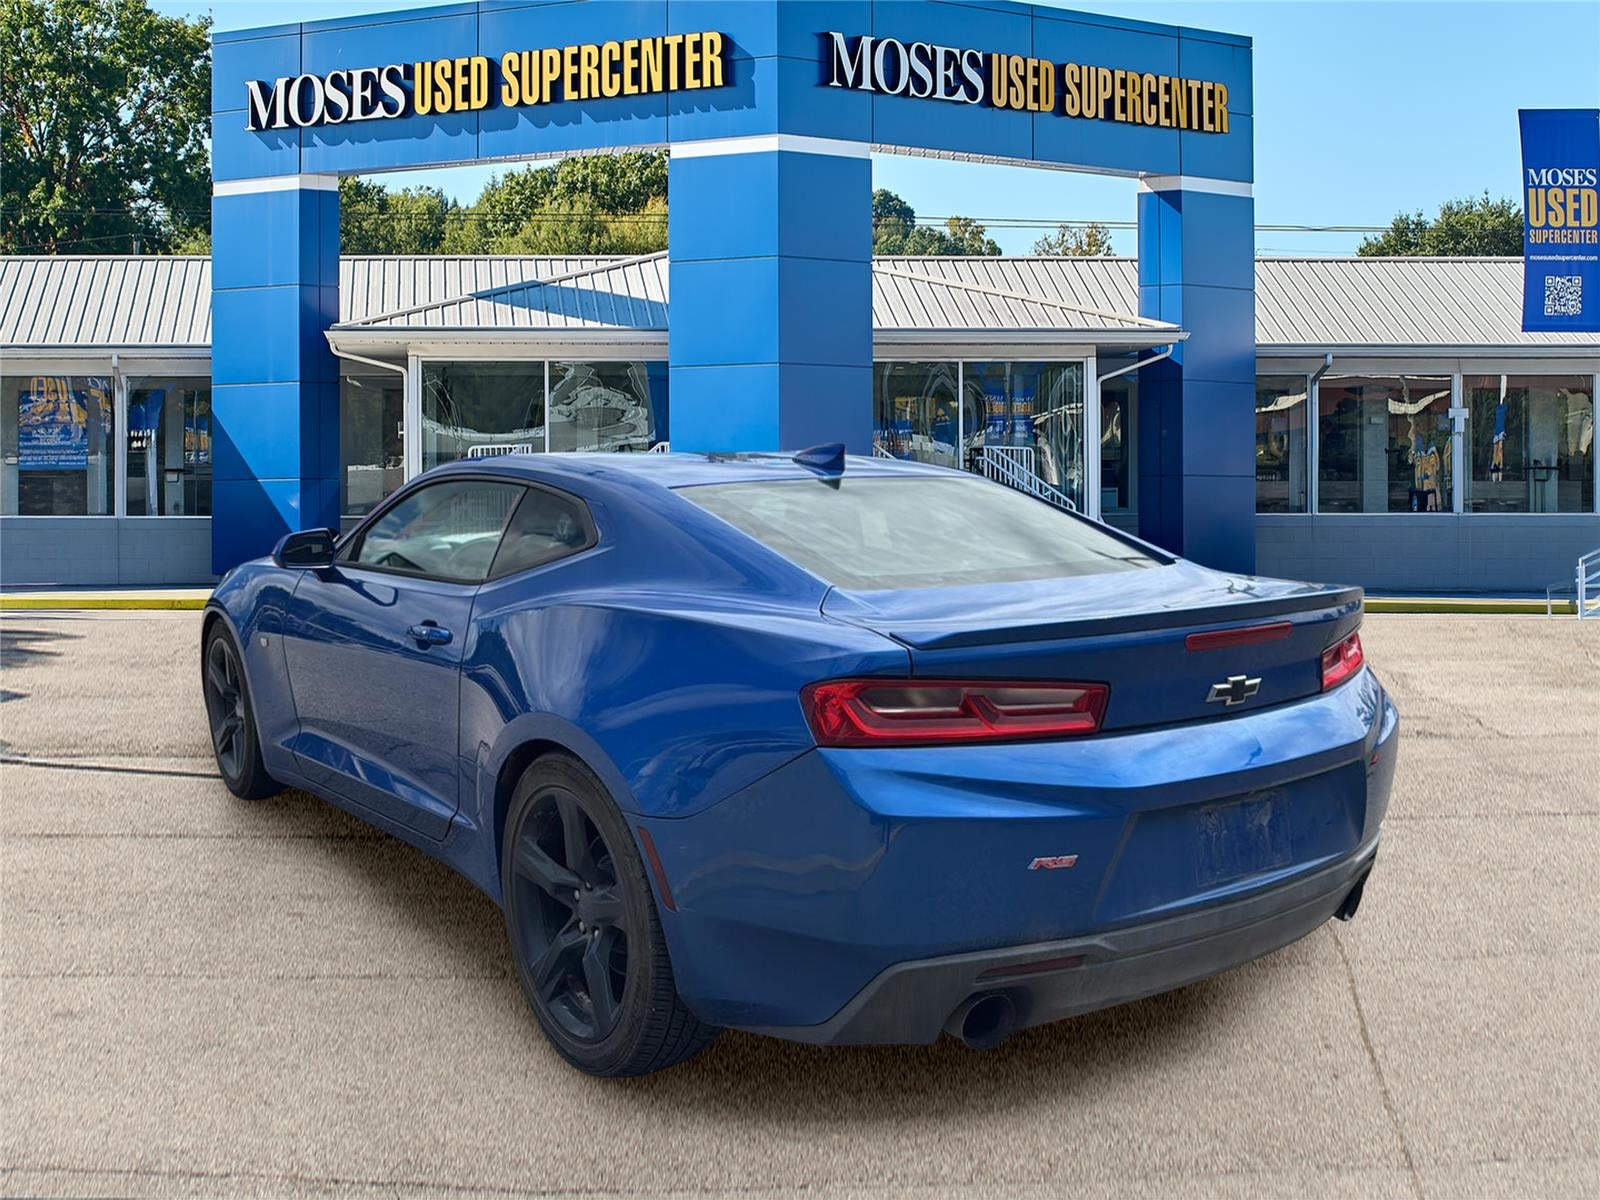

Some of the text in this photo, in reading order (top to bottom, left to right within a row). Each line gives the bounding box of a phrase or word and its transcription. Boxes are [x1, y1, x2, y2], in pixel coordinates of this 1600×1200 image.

[244, 31, 724, 132] MOSES USED SUPERCENTER
[828, 31, 1229, 133] MOSES USED SUPERCENTER
[1527, 168, 1597, 187] MOSES
[1529, 188, 1598, 228] USED
[1529, 229, 1598, 245] SUPERCENTER
[1027, 854, 1079, 870] RS
